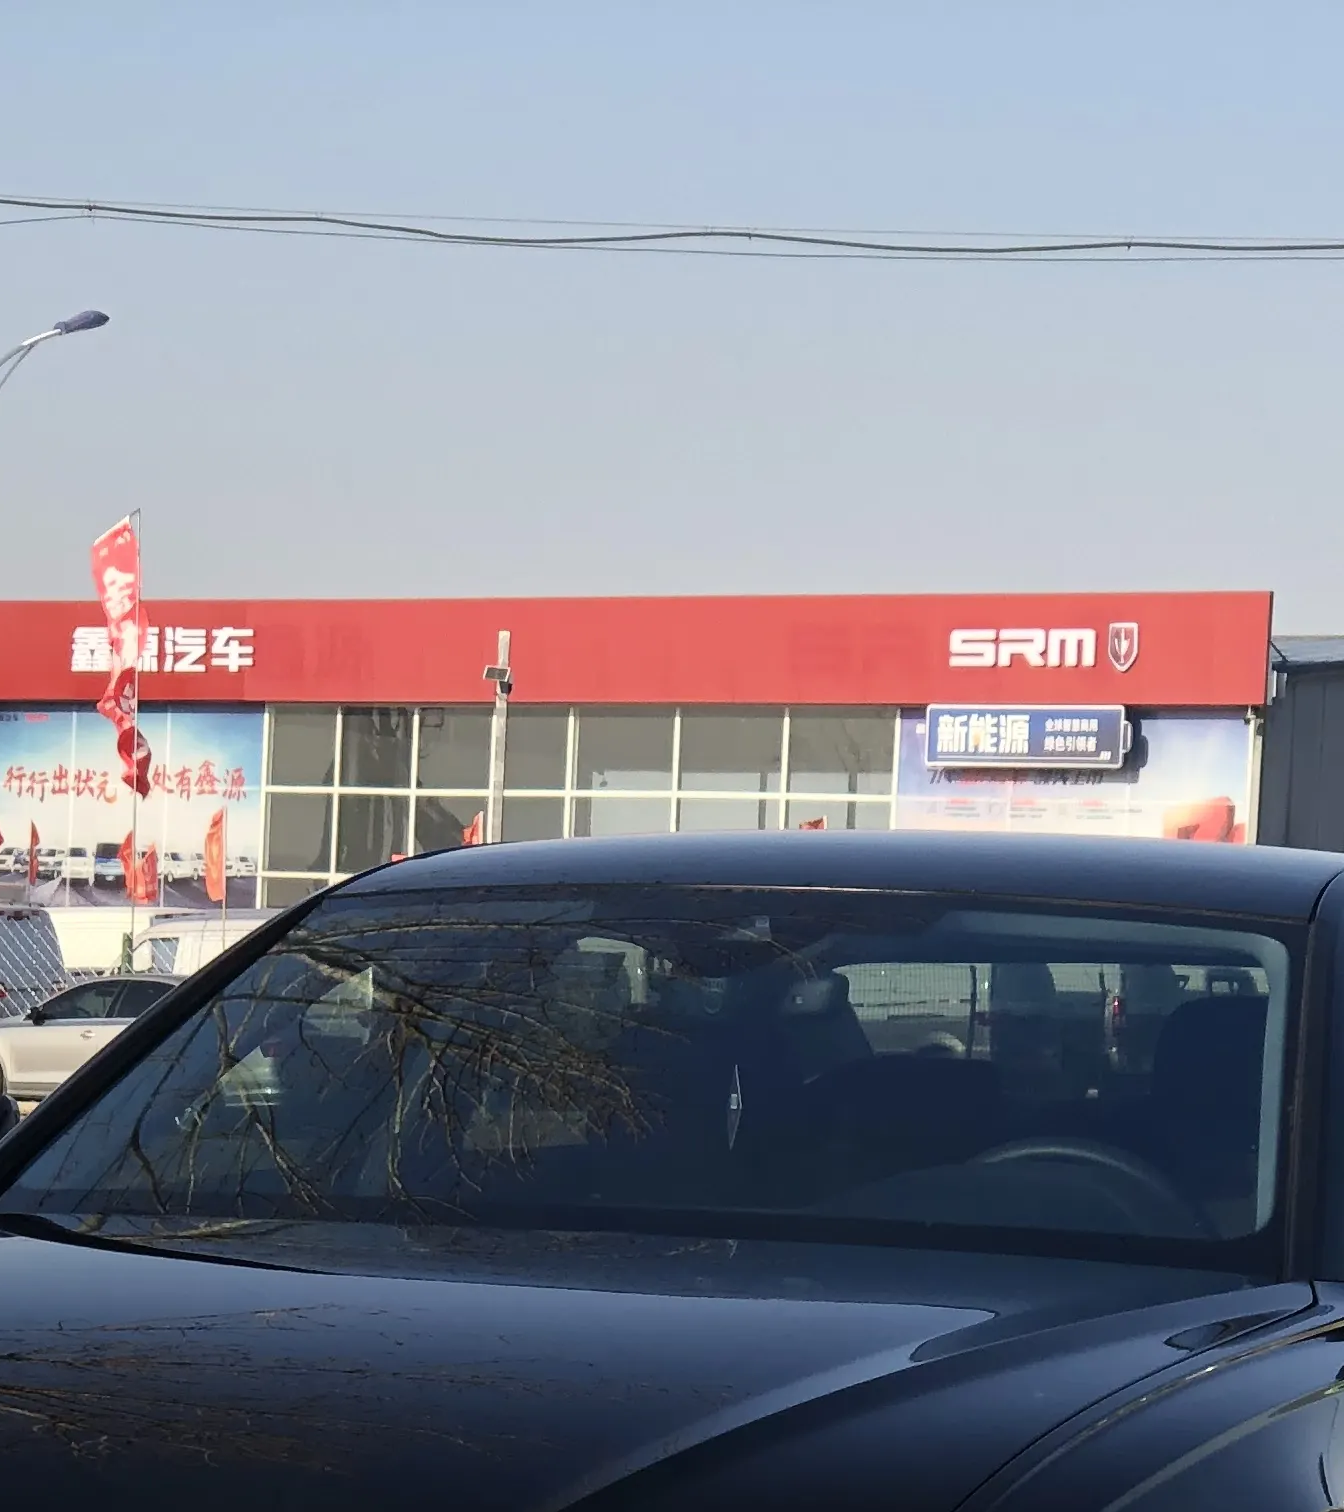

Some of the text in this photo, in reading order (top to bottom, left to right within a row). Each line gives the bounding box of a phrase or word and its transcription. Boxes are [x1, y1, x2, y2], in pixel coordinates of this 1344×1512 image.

[949, 628, 1097, 667] SRM
[937, 714, 1030, 754] 新能源
[2, 764, 118, 804] 行行出状元
